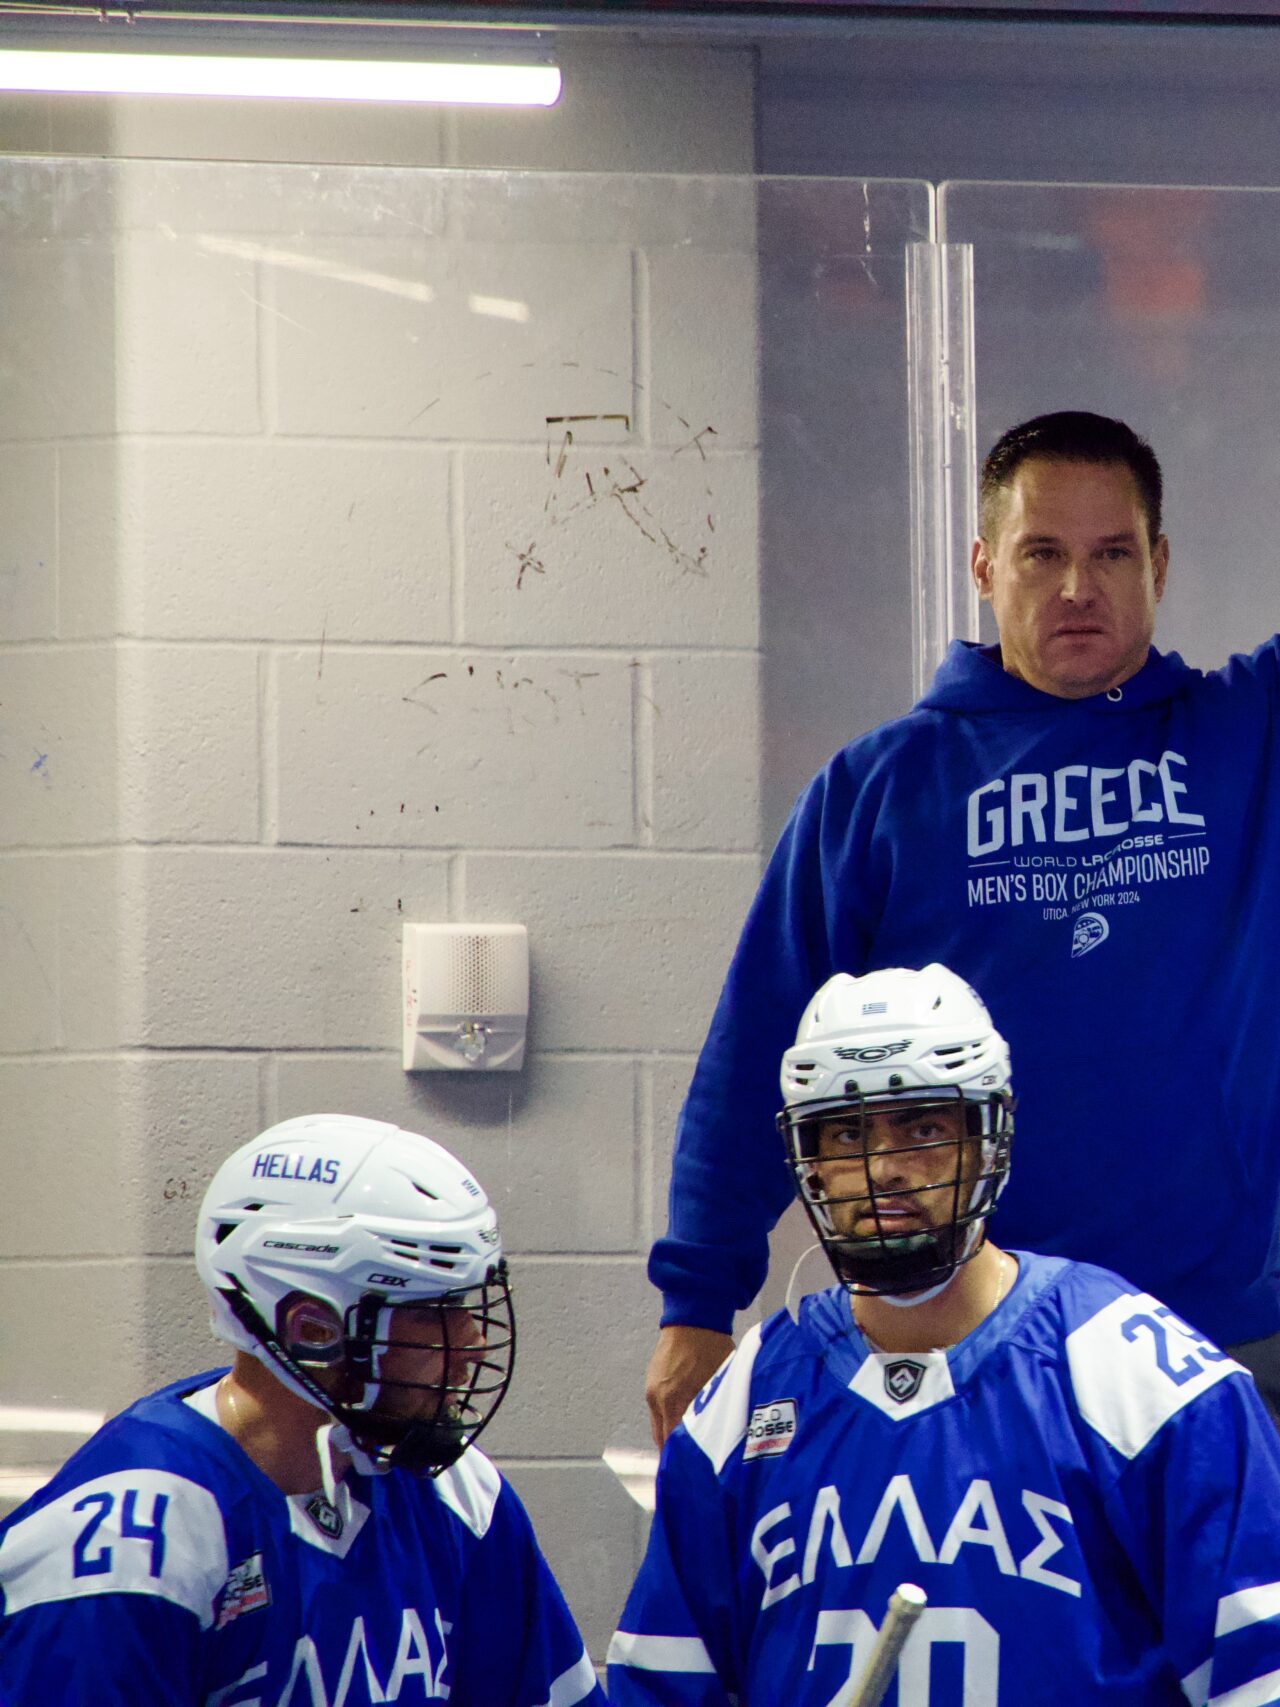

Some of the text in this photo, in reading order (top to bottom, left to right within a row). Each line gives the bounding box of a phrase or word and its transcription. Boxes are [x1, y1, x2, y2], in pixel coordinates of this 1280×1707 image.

[967, 750, 1206, 858] GREECE
[1013, 834, 1164, 868] WORLD LACROSSE
[967, 846, 1210, 907] MEN'S BOX CHAMPIONSHIP
[1091, 893, 1115, 908] YORK
[1117, 891, 1140, 905] 2024
[252, 1153, 340, 1184] HELLAS
[262, 1239, 340, 1254] cascade
[367, 1272, 411, 1288] CBX
[73, 1489, 169, 1579] 24
[750, 1474, 1082, 1610] ΕΛΛΑΣ
